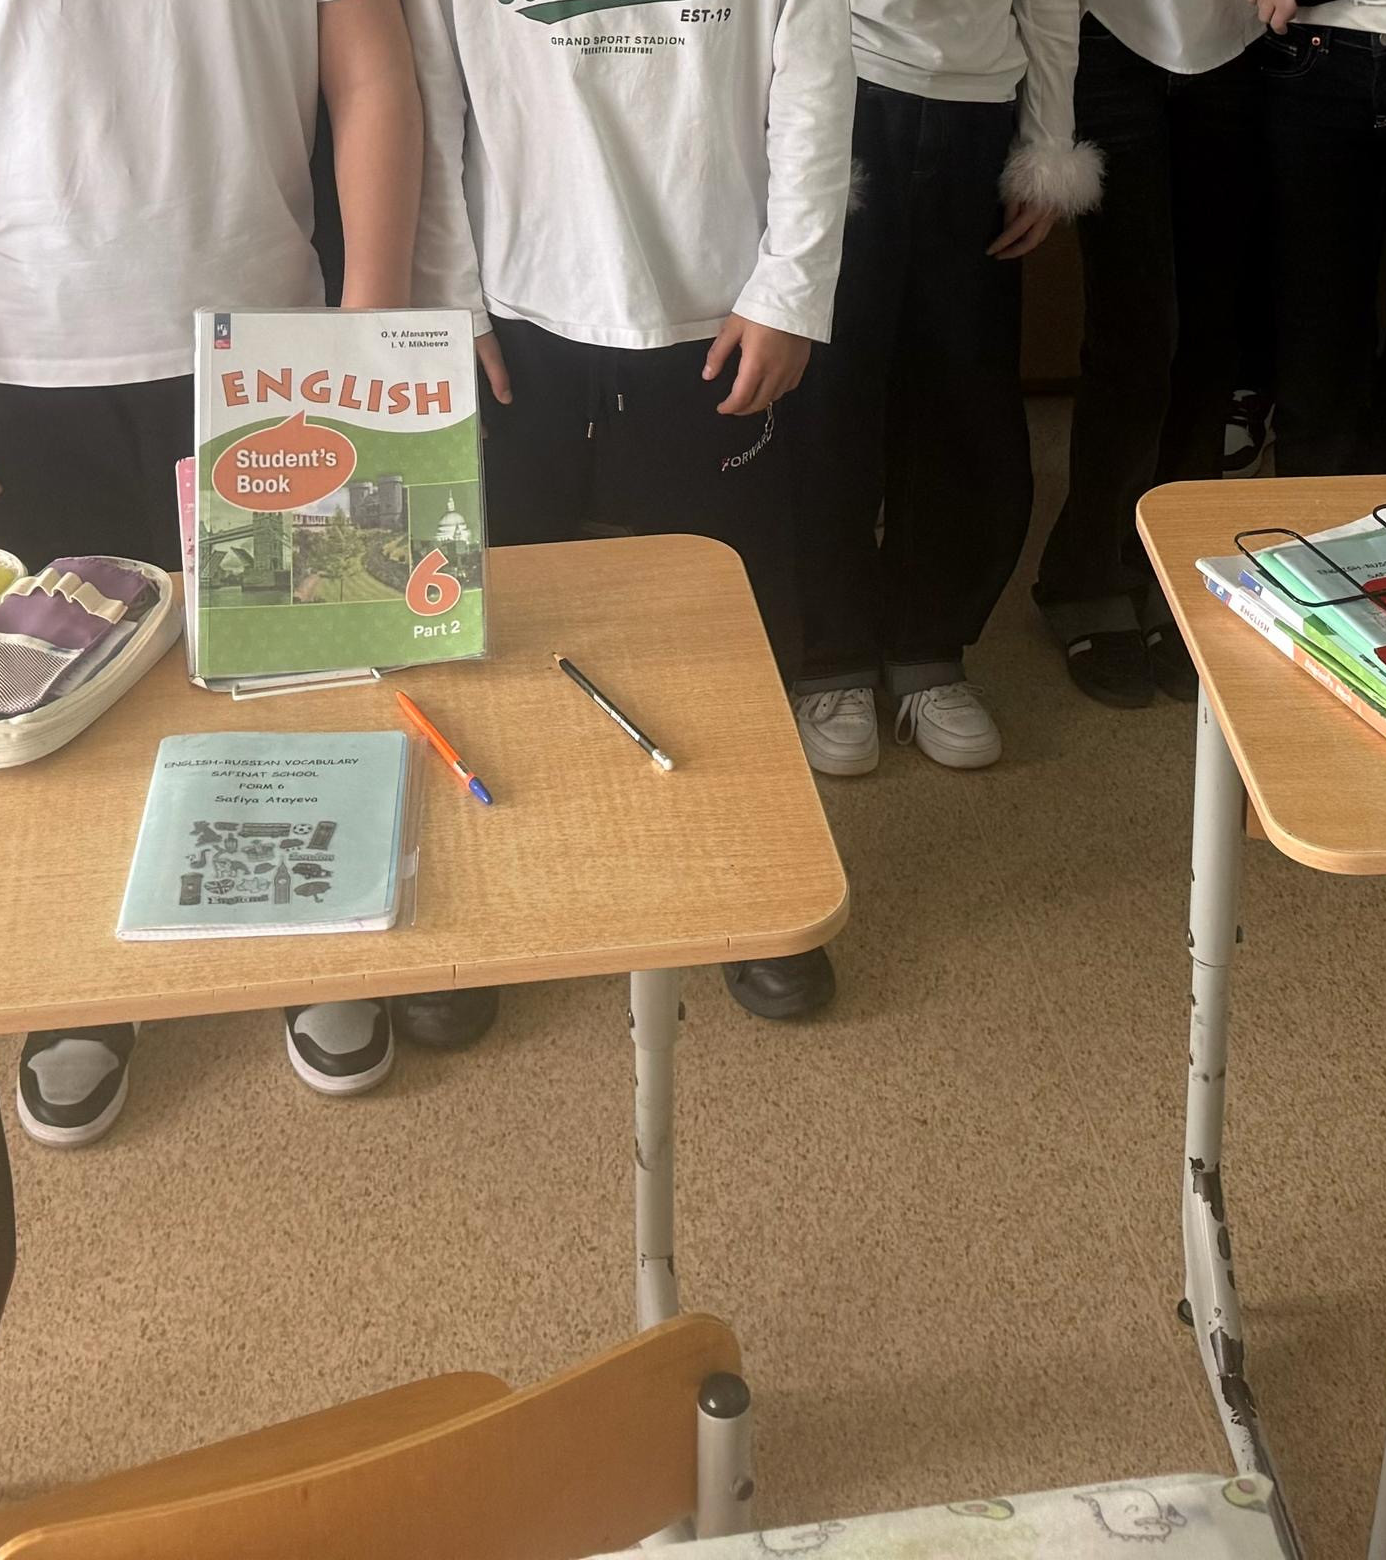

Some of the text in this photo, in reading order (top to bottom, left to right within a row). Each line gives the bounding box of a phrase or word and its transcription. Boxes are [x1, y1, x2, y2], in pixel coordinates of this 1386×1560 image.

[551, 35, 685, 47] GRAND SPORT STADION
[221, 367, 452, 415] ENGLISH
[236, 448, 338, 469] Student's
[237, 474, 291, 493] Book
[405, 547, 462, 617] 6
[1240, 604, 1271, 634] ENGLISH
[413, 620, 461, 639] Part 2
[164, 758, 360, 769] ENGLISH-RUSSIAN VOCABULARY
[215, 795, 318, 805] Safiya Atayeva
